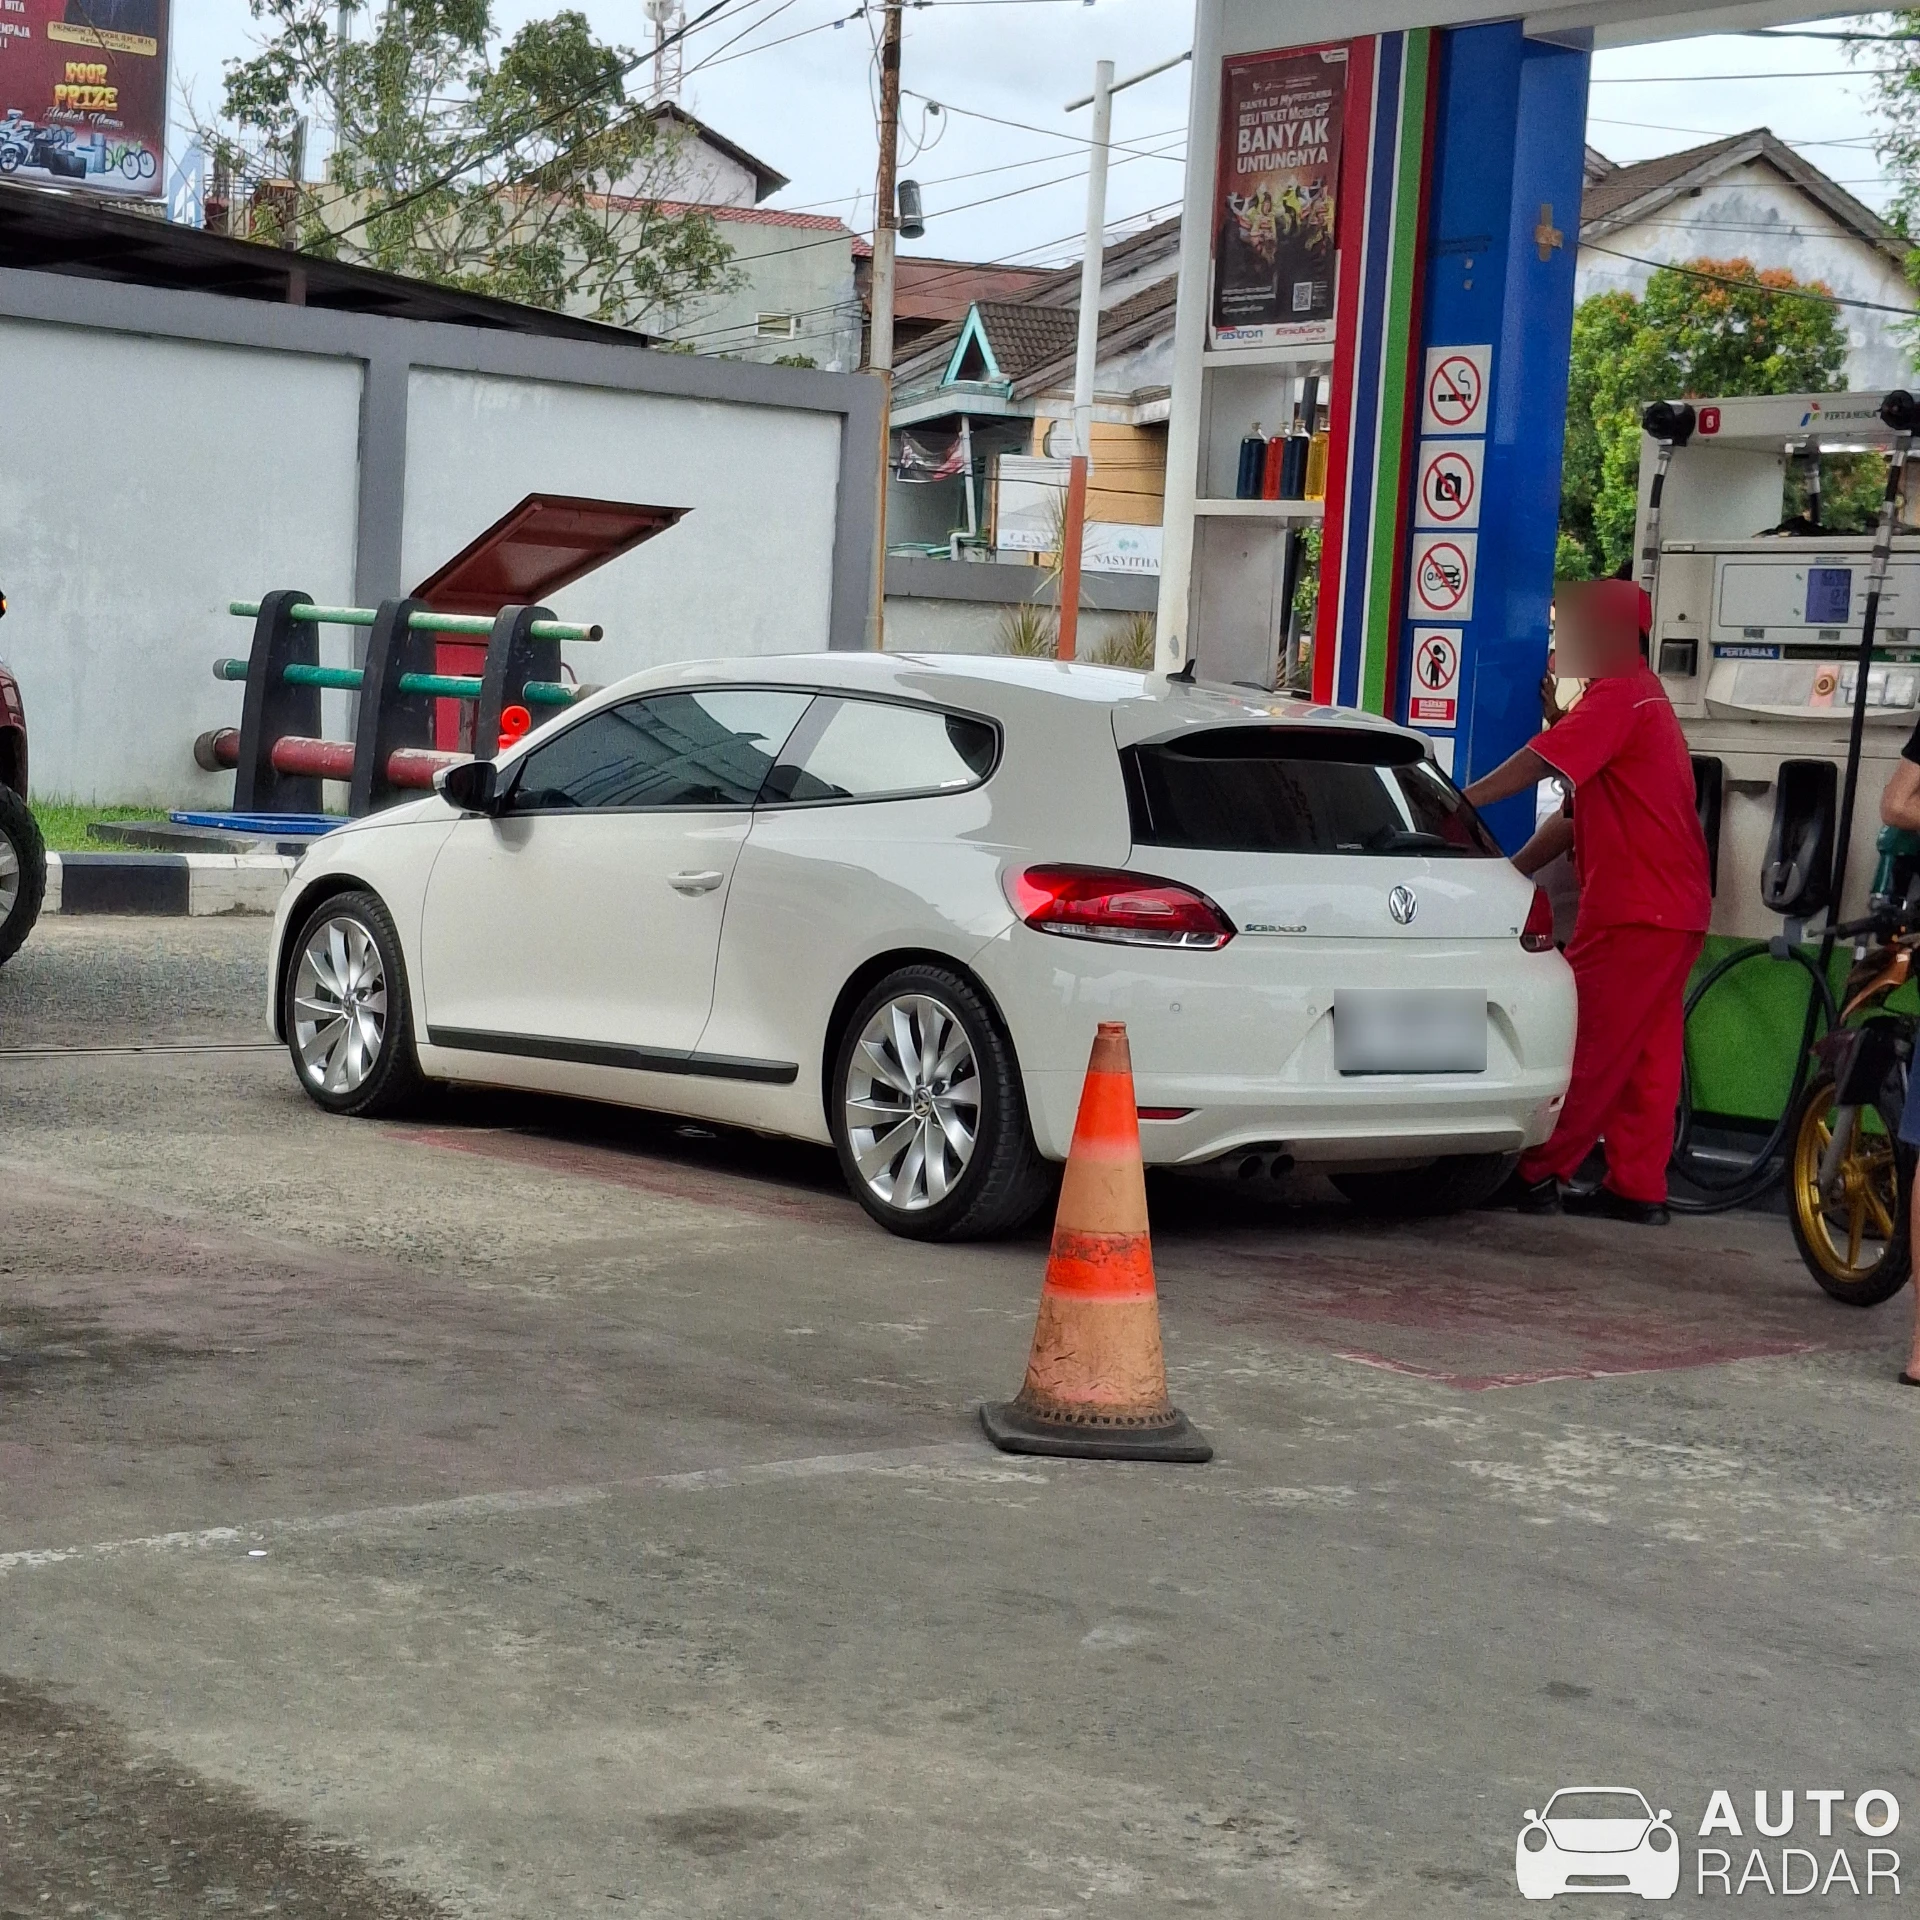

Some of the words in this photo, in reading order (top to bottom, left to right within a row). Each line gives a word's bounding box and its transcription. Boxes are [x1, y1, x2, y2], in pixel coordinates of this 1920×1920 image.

[54, 84, 118, 111] PRIZE
[1238, 118, 1329, 154] BANYAK
[1236, 147, 1328, 173] UNTUNGNYA
[1094, 554, 1159, 568] NASYITHA
[1720, 646, 1774, 657] PERTAMAX
